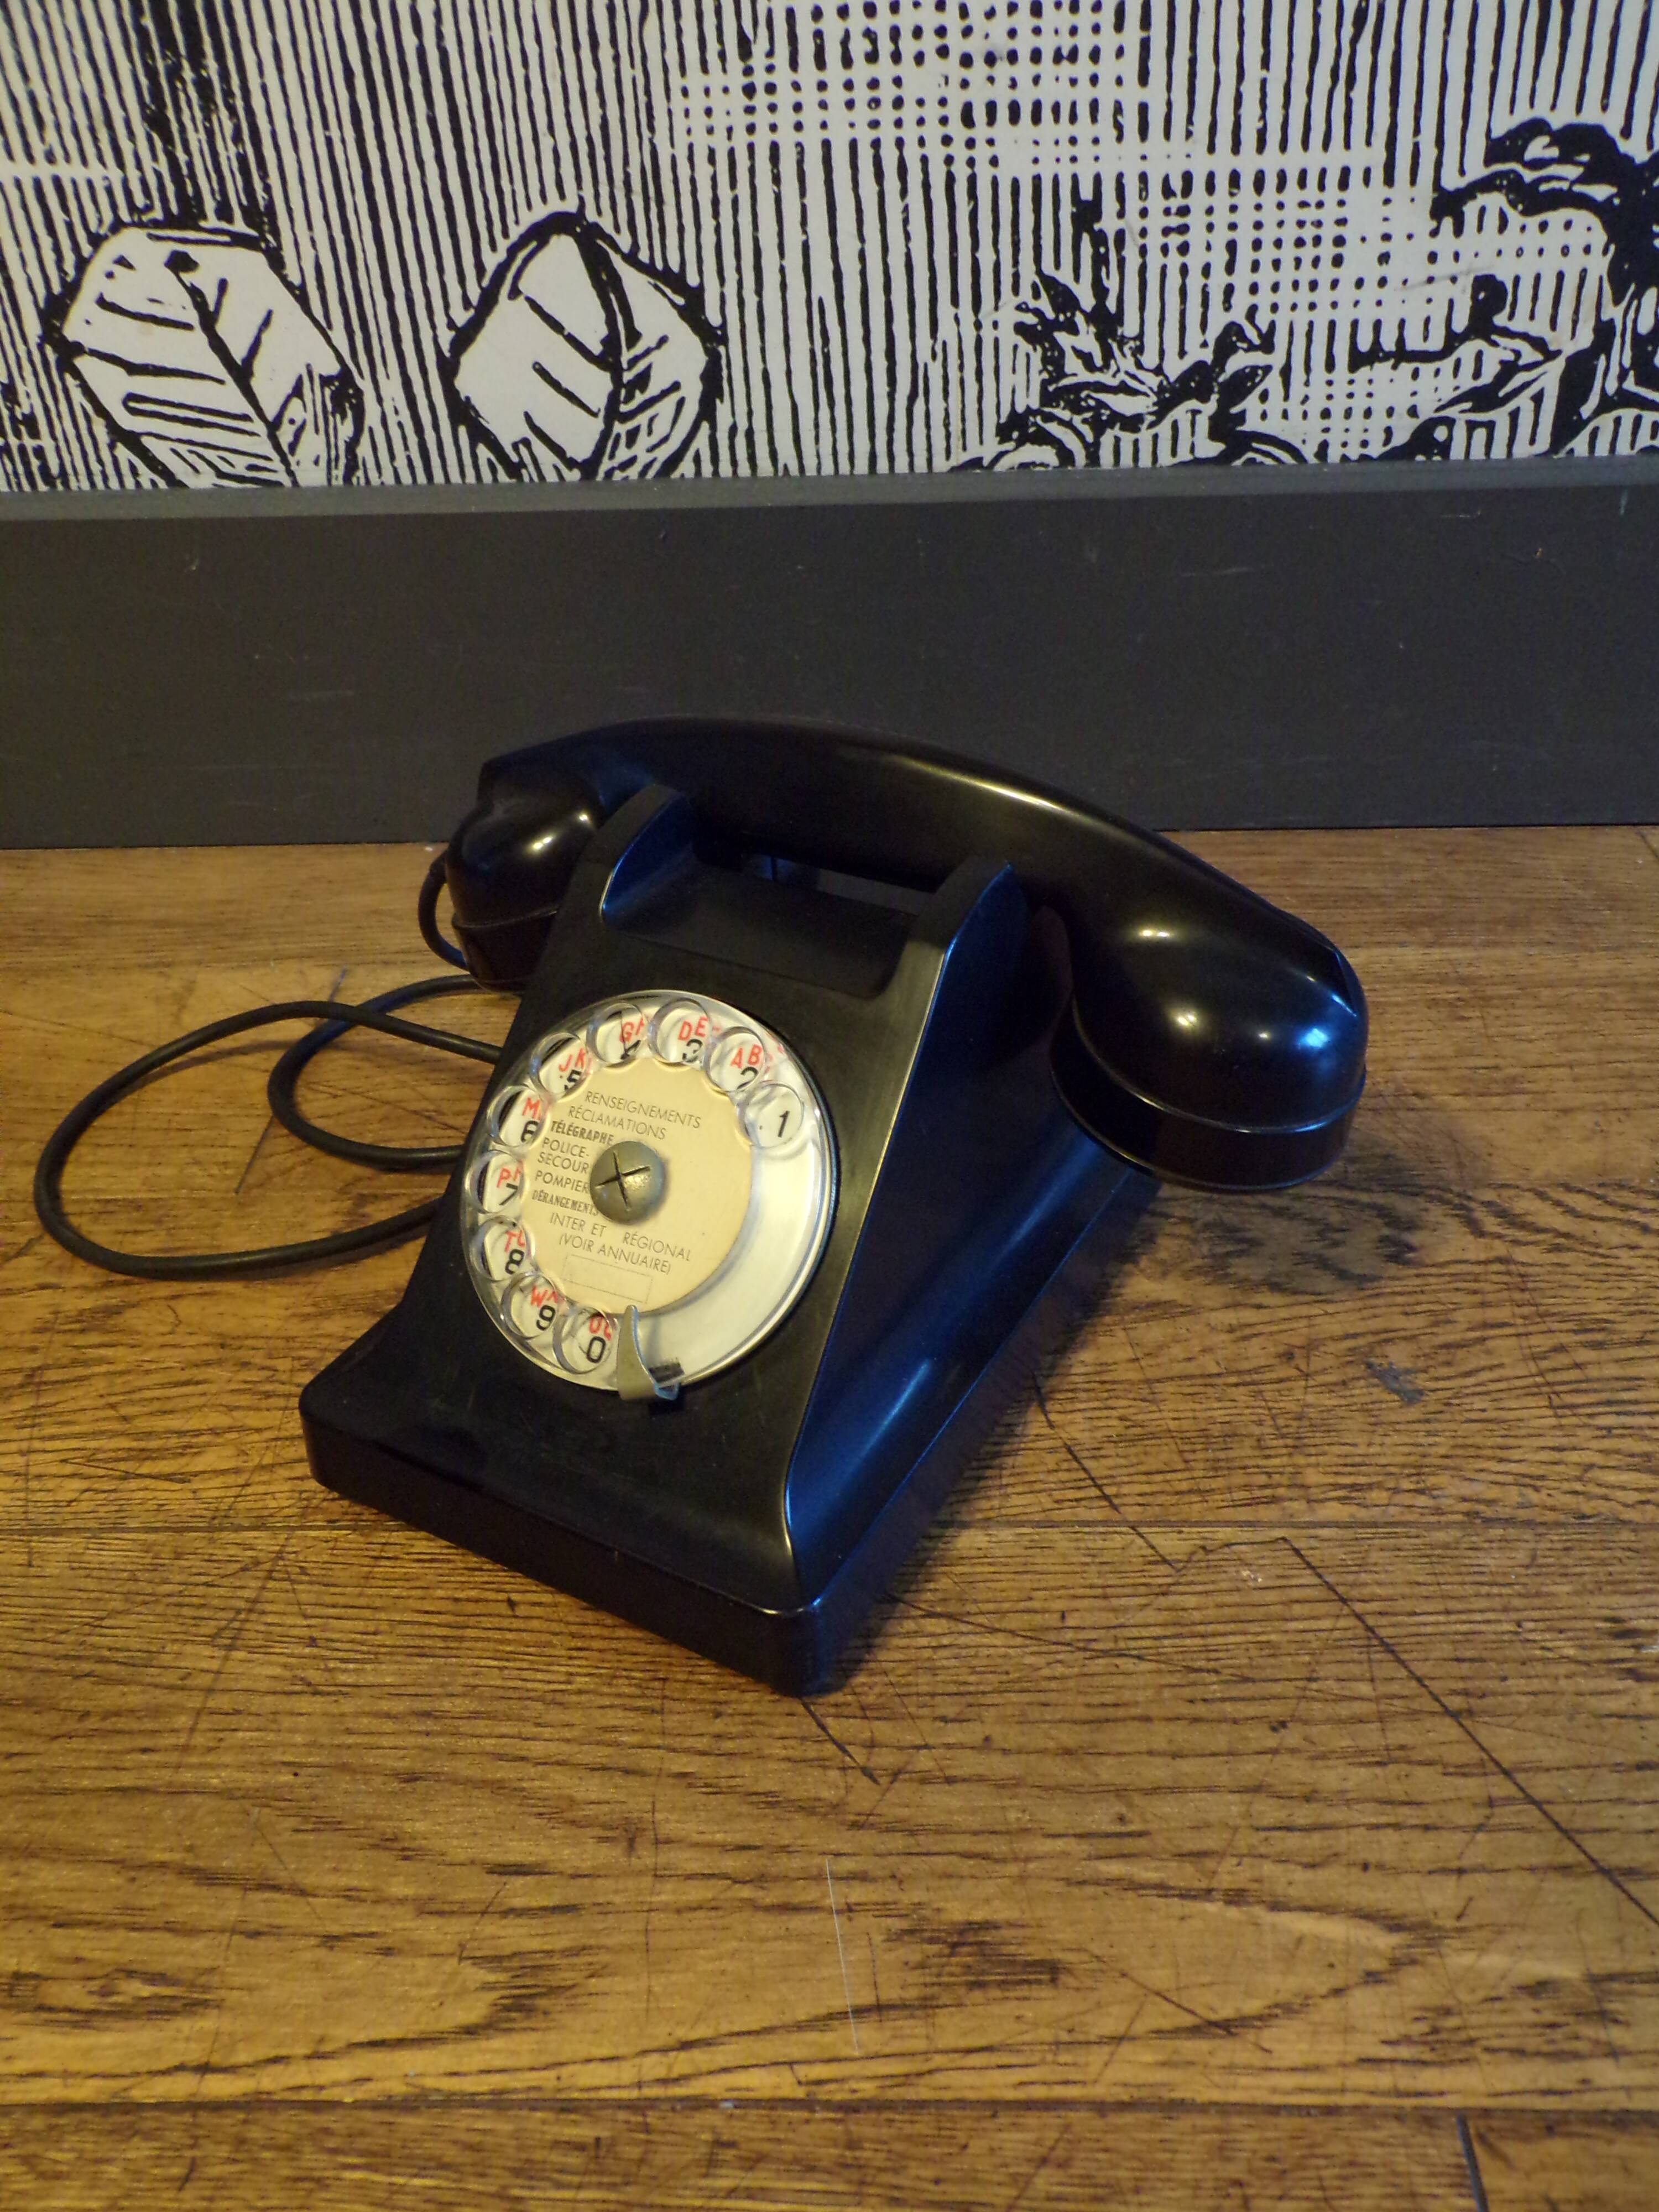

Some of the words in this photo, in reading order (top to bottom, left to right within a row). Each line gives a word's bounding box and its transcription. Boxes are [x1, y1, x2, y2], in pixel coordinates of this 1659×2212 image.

[682, 1039, 703, 1063] 3
[737, 1066, 759, 1090] 2
[568, 1105, 666, 1140] RÉCLAMATIONS
[585, 1091, 702, 1129] RENSEIGNEMENTS
[520, 1120, 540, 1143] 6
[550, 1120, 614, 1146] TÉLÉGRAPHE
[778, 1110, 790, 1138] 1
[542, 1137, 589, 1158] POLICE-
[499, 1183, 518, 1206] 7
[532, 1190, 599, 1216] DÉRANGEMENTS
[550, 1212, 585, 1232] INTER
[591, 1223, 607, 1237] ET
[623, 1232, 691, 1261] RÉGIONAL
[505, 1249, 525, 1274] 8
[559, 1232, 594, 1253] (VOIR
[597, 1244, 671, 1275] ANNUAIRE)
[536, 1305, 556, 1331] 9
[586, 1336, 606, 1363] 0
